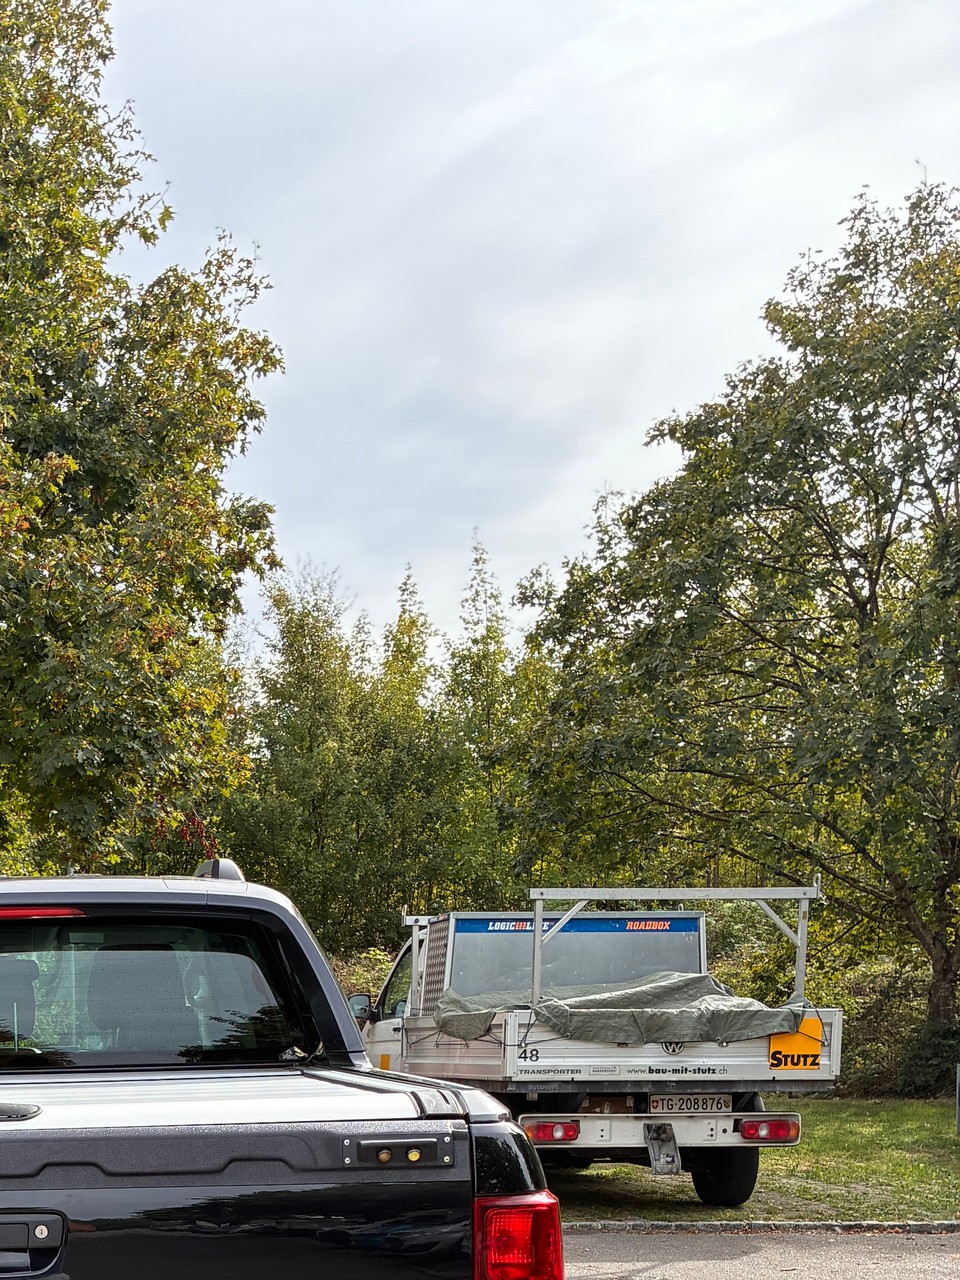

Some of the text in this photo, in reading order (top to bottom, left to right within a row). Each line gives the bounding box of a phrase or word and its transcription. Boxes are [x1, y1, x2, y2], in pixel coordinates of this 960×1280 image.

[487, 921, 550, 931] LOGIC LIE
[625, 921, 671, 930] ROADBOX
[518, 1048, 540, 1062] 48
[769, 1050, 821, 1068] STUTZ
[626, 1065, 729, 1075] www.bau-mit-stutz.ch
